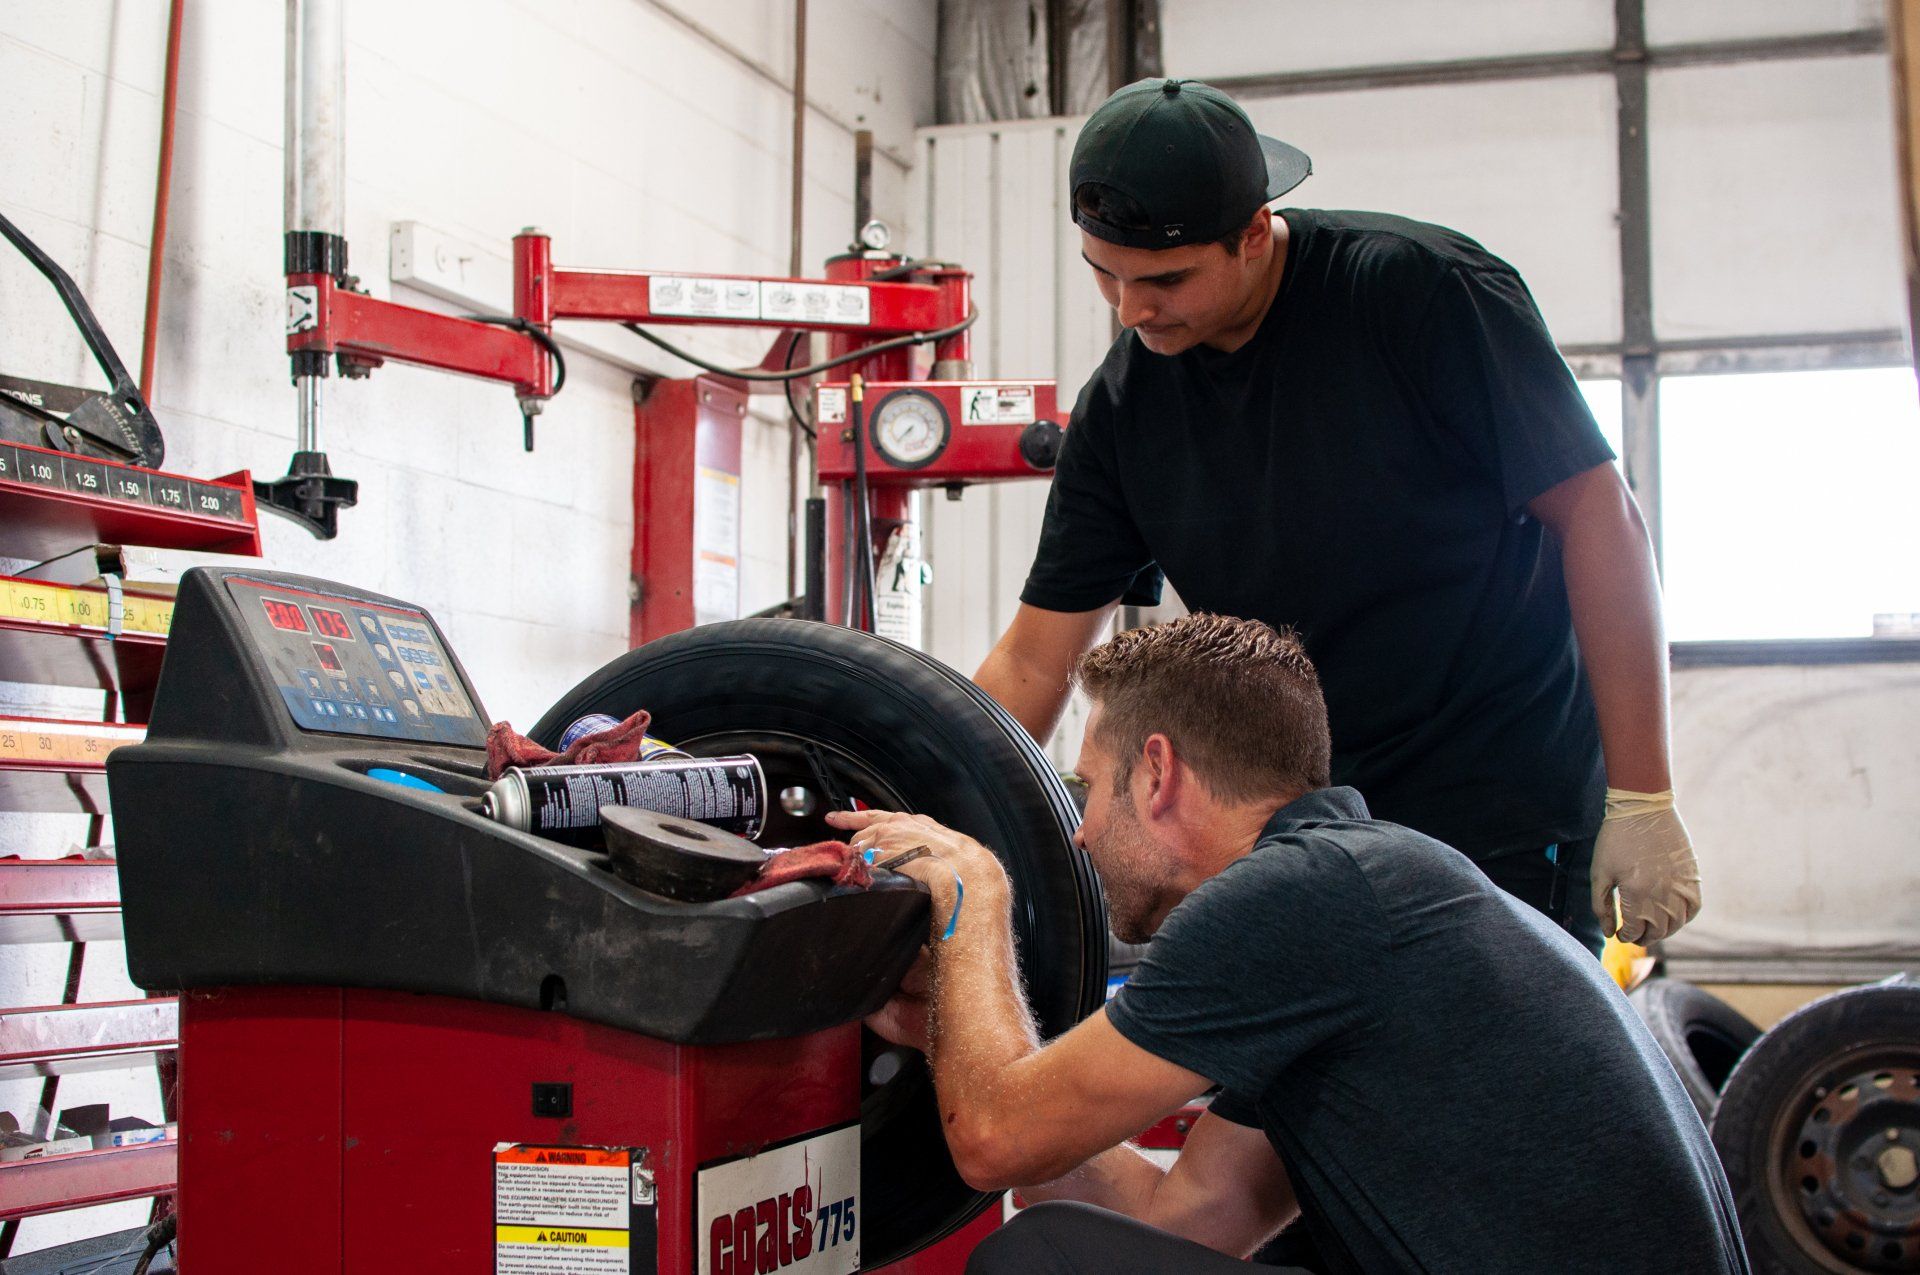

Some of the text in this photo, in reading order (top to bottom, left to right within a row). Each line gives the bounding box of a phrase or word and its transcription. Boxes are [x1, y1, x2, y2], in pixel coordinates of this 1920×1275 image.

[30, 464, 52, 480] 1.00
[75, 473, 97, 488] 1.25
[119, 481, 139, 496] 1.50
[161, 489, 181, 504] 1.75
[201, 496, 219, 511] 2.00
[22, 596, 171, 625] 0.75 1.00 25 1.5
[2, 735, 98, 752] 25 30 35
[549, 1152, 586, 1164] WARNING
[818, 1196, 855, 1253] 775
[550, 1231, 587, 1244] CAUTION
